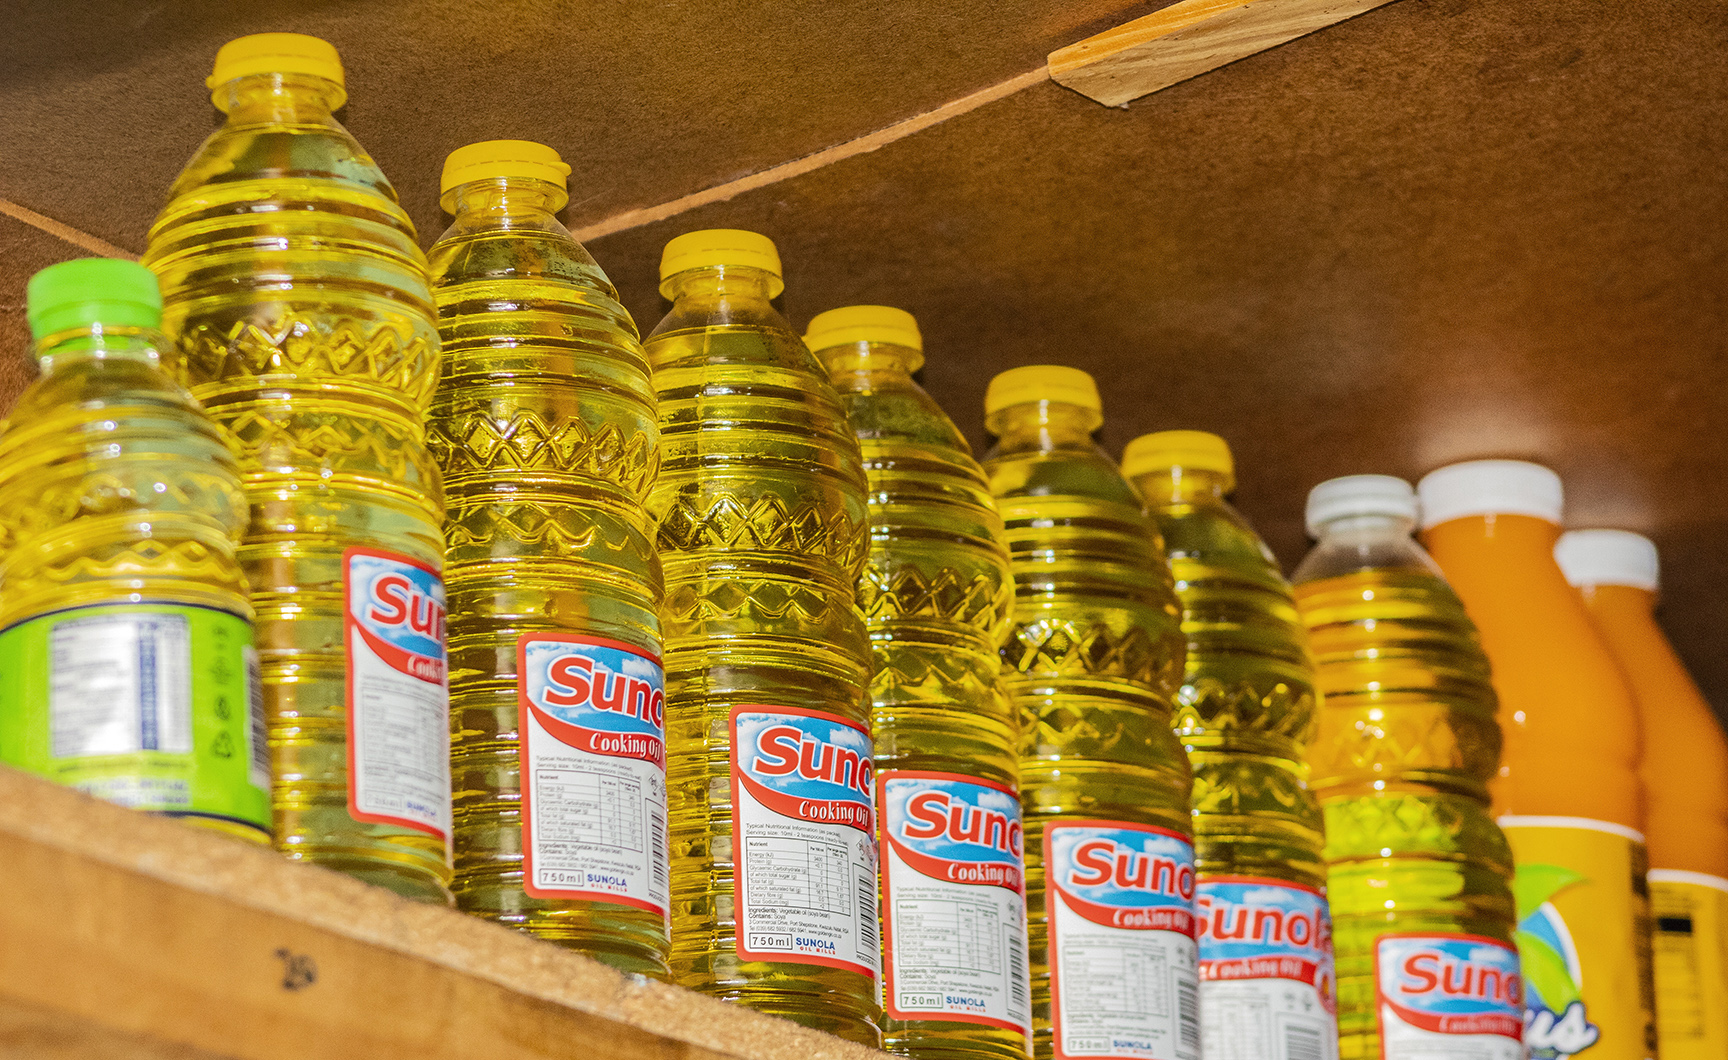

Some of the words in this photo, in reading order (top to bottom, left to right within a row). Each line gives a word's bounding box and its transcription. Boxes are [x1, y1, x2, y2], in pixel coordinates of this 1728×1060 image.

[543, 655, 664, 729] Suno
[590, 733, 647, 758] Cooking
[752, 725, 872, 798] Suno
[799, 800, 854, 824] Cooking
[856, 807, 869, 827] Oil
[902, 790, 1022, 858] Suno
[543, 873, 580, 883] 750ml
[587, 874, 627, 887] SUNOLA
[948, 863, 1004, 886] Cooking
[1068, 838, 1195, 902] Suno
[753, 937, 789, 946] 750ml
[796, 937, 835, 950] SUNOLA
[1400, 951, 1522, 1006] Suno
[904, 997, 940, 1005] 750ml
[946, 996, 985, 1007] SUNOLA
[1522, 1003, 1597, 1055] us
